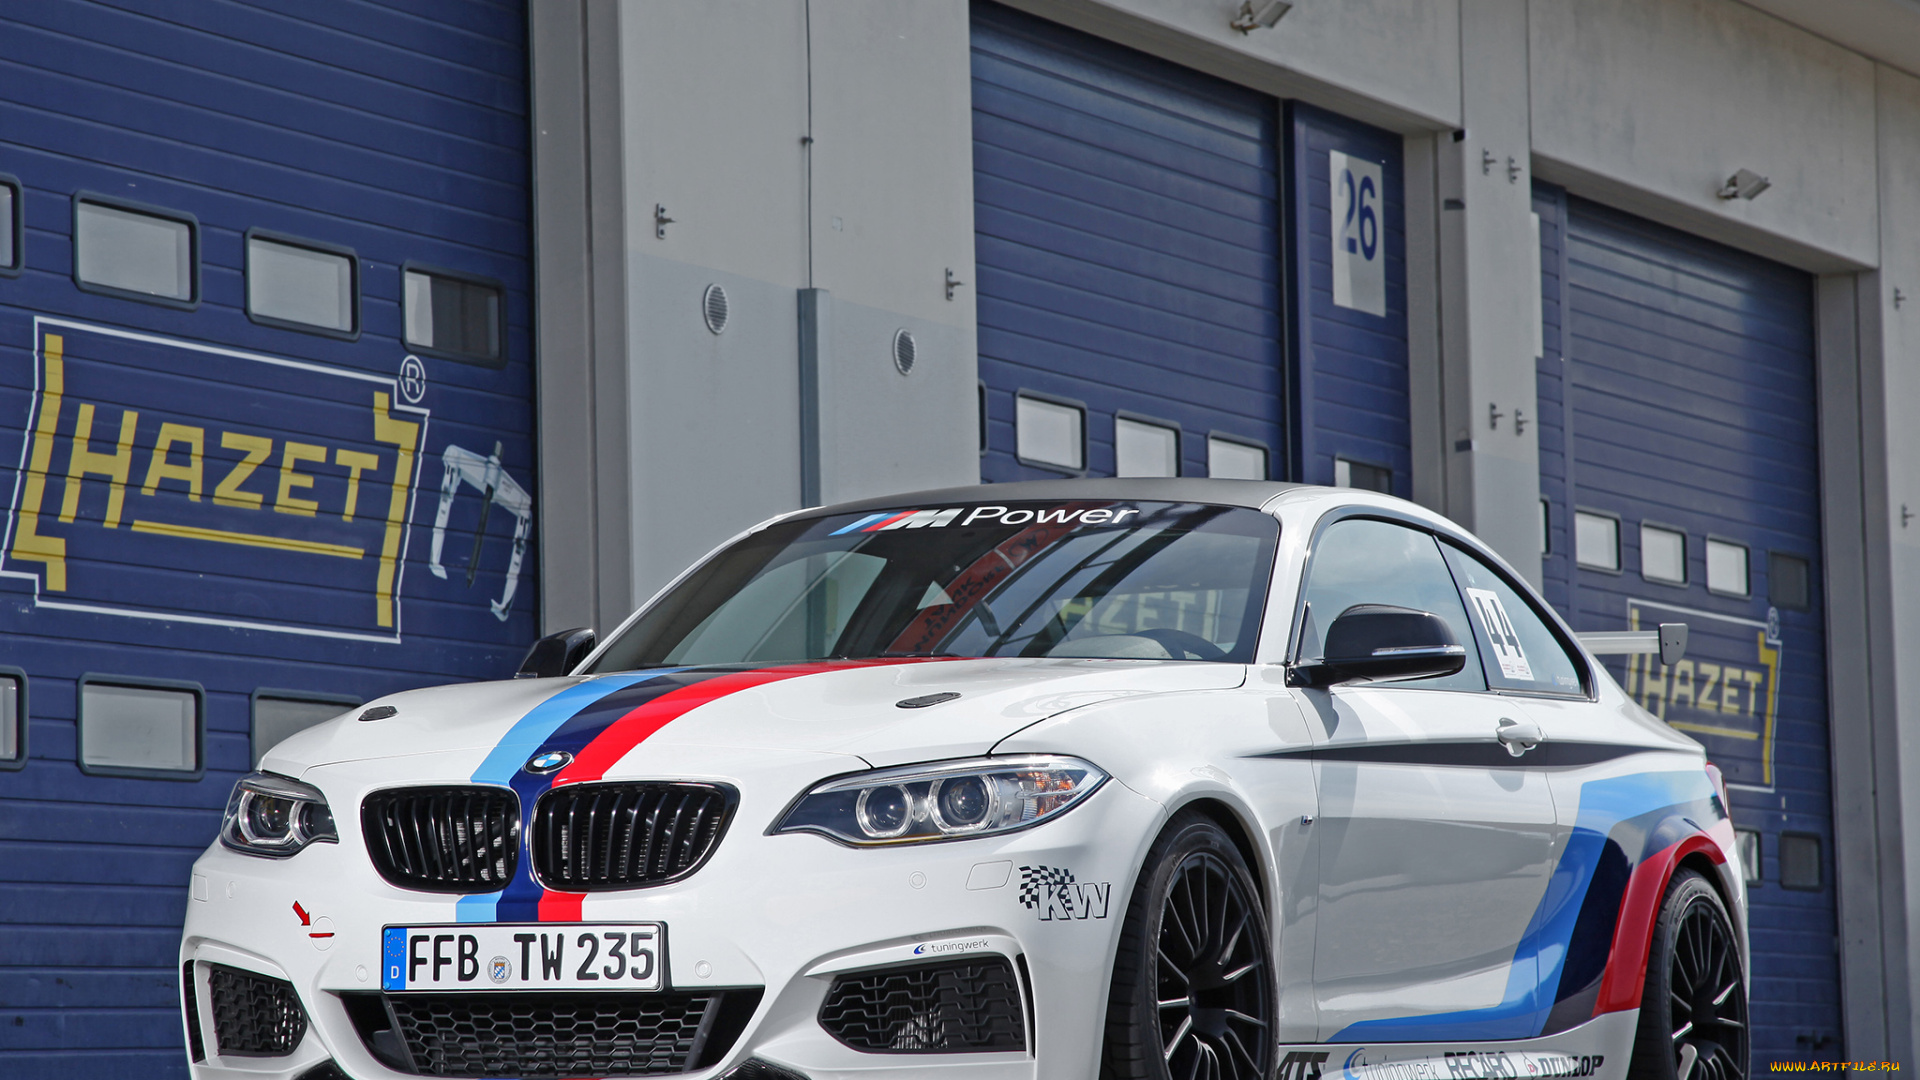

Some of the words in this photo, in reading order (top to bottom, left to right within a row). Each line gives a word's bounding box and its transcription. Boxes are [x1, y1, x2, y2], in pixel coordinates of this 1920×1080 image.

[1337, 168, 1377, 262] 26
[58, 403, 379, 529] HAZET
[960, 506, 1140, 526] Power
[1475, 596, 1522, 658] 44
[1642, 650, 1763, 722] HAZET
[1037, 882, 1111, 921] KW
[409, 934, 480, 982] FFB
[513, 933, 564, 981] TW
[576, 932, 654, 981] 235
[931, 939, 990, 953] tuningwerk
[390, 965, 399, 979] D
[1444, 1051, 1518, 1080] RECARO
[1538, 1055, 1604, 1078] DUNLOP
